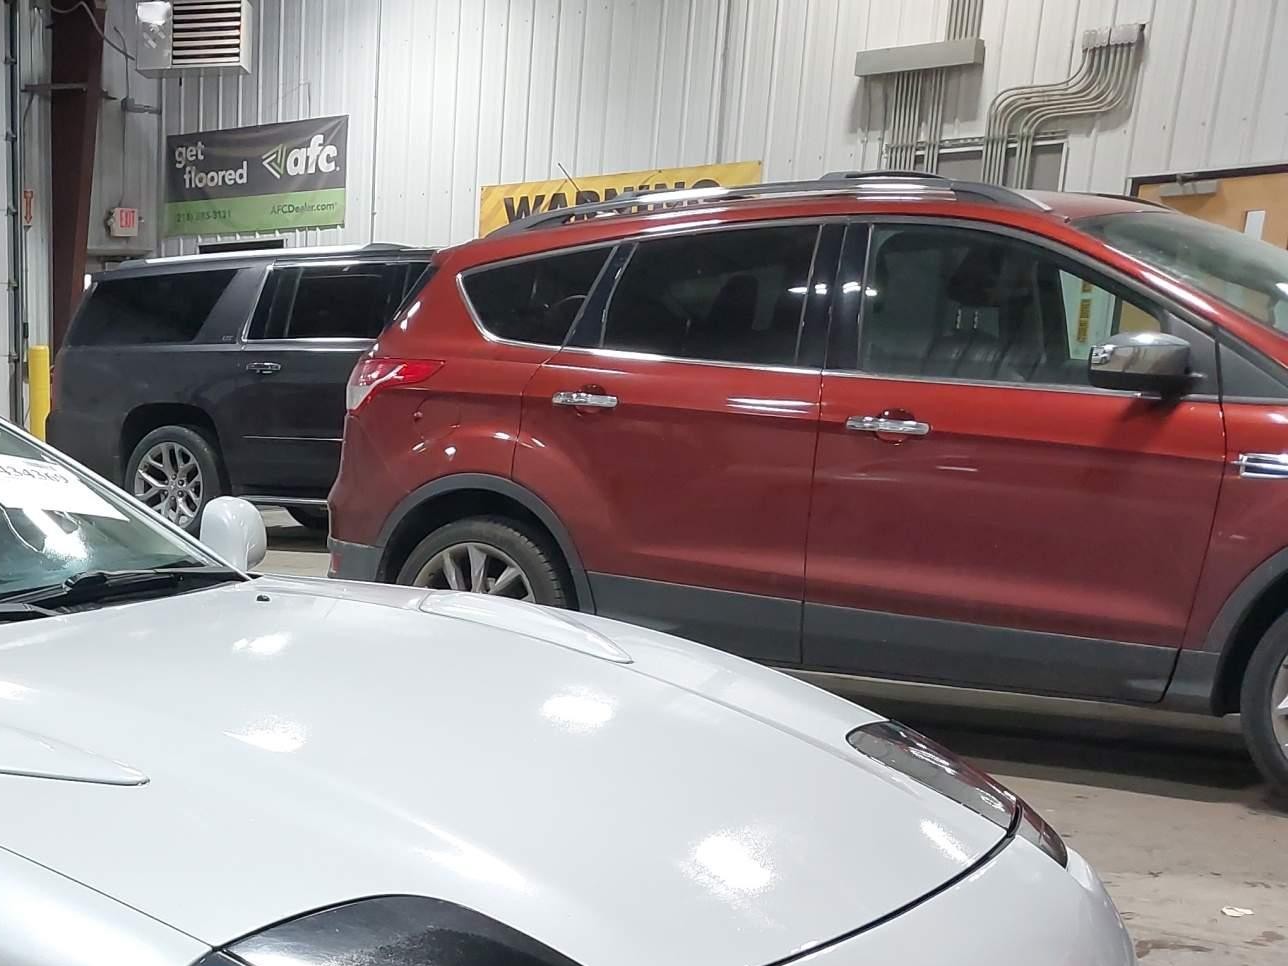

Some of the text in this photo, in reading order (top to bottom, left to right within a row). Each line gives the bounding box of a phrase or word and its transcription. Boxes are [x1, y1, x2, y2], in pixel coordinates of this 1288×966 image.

[175, 141, 204, 168] get
[184, 161, 248, 188] floored
[119, 209, 135, 228] EXIT
